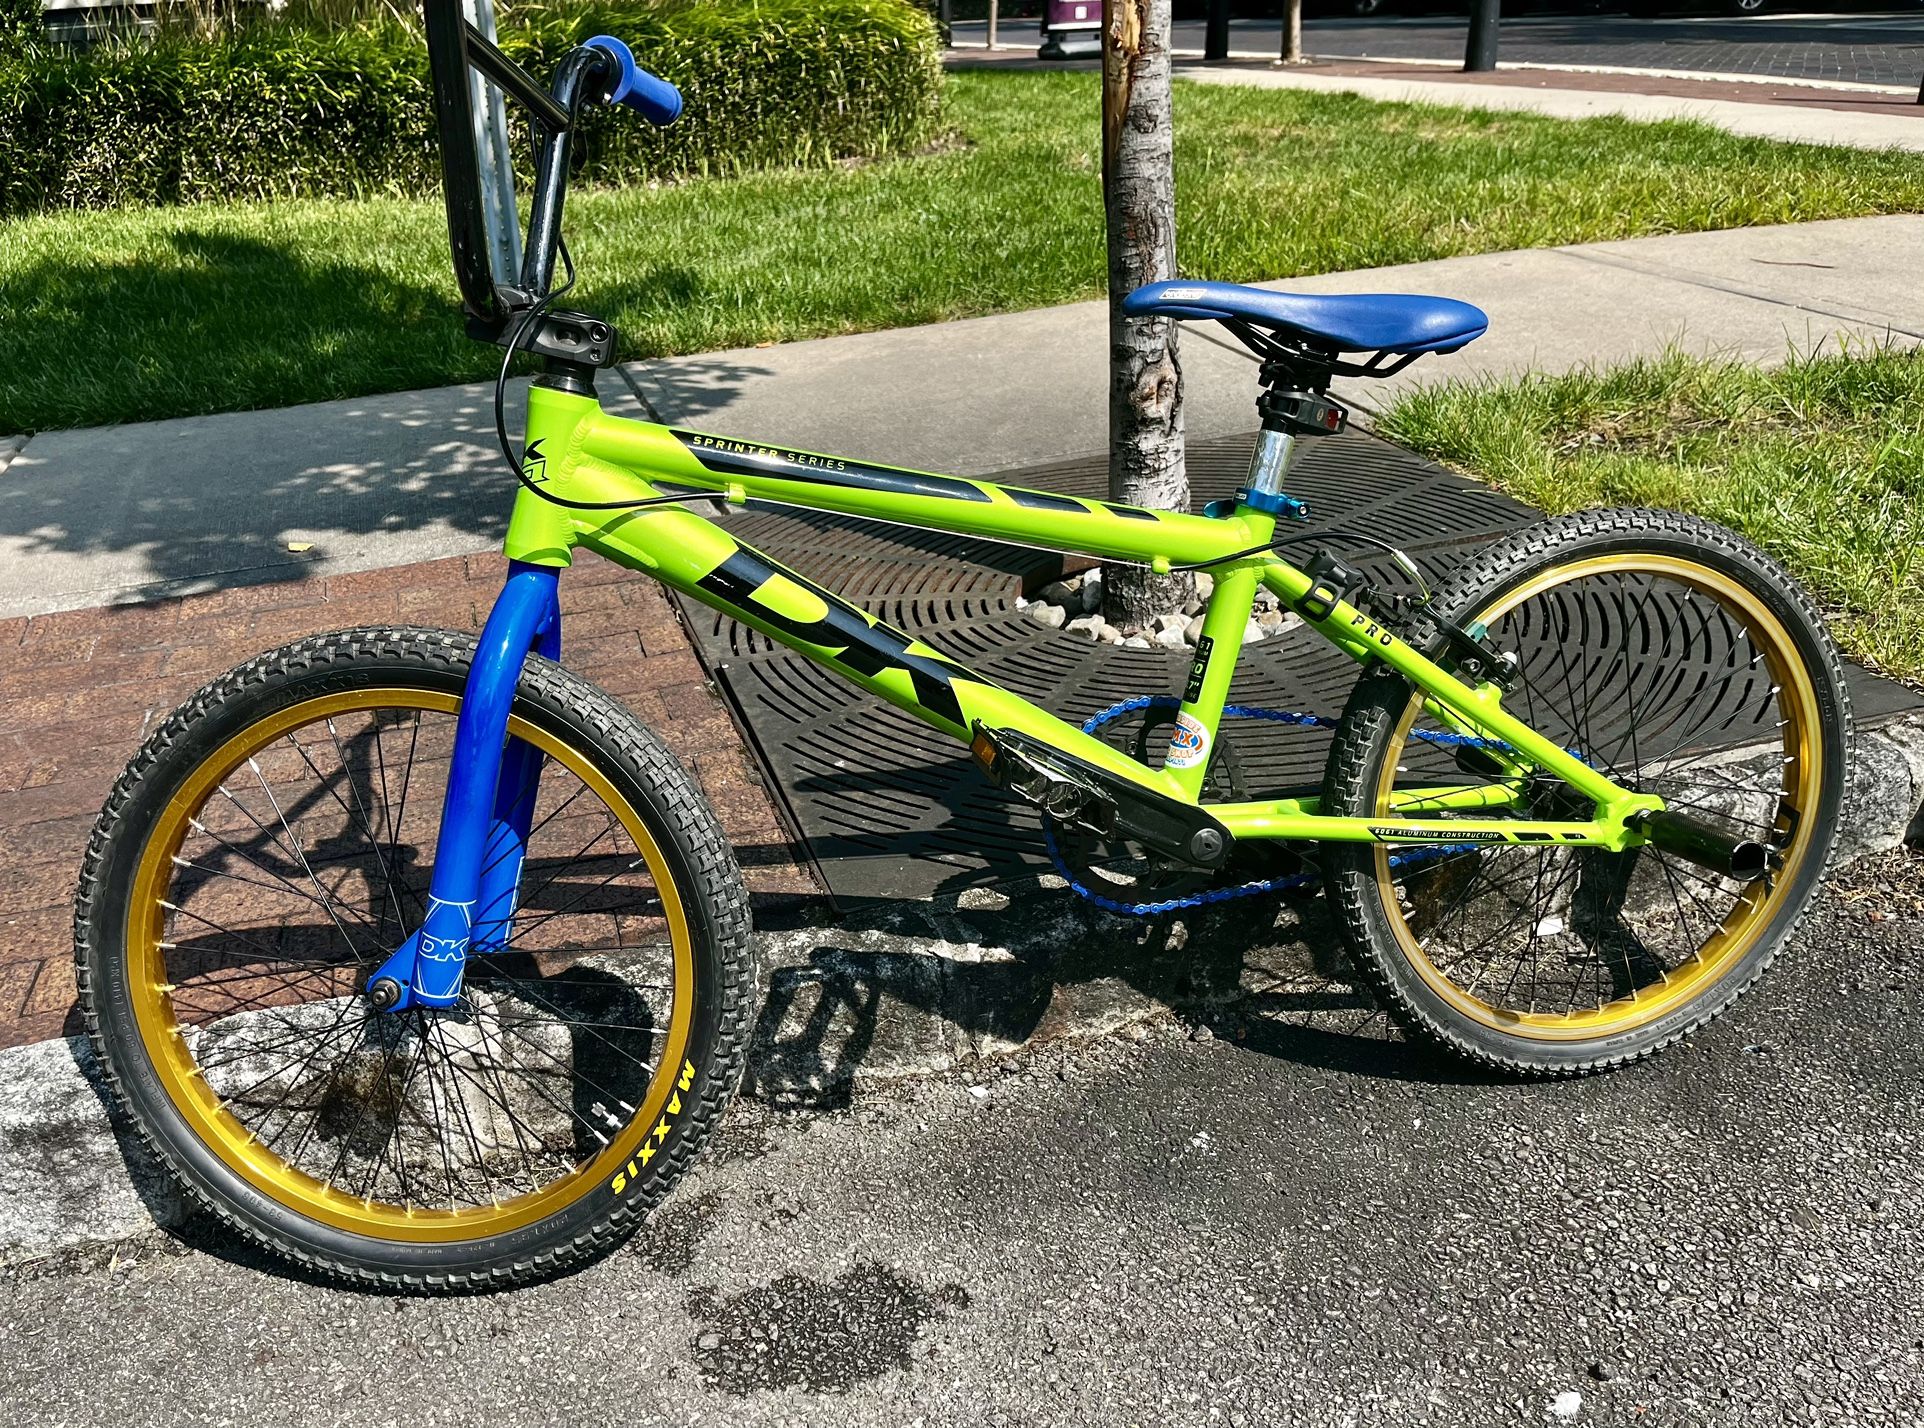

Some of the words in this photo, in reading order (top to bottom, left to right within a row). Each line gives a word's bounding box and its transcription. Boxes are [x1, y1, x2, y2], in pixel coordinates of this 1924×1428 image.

[692, 435, 778, 459] SPRINTER
[786, 452, 846, 471] SERIES
[695, 537, 1002, 732] DK
[1350, 614, 1393, 646] PRO
[1397, 829, 1439, 837] ALUMINUM
[1441, 831, 1500, 839] CONSTRUCTION
[418, 931, 470, 962] DK
[611, 1058, 697, 1196] MAXXIS
